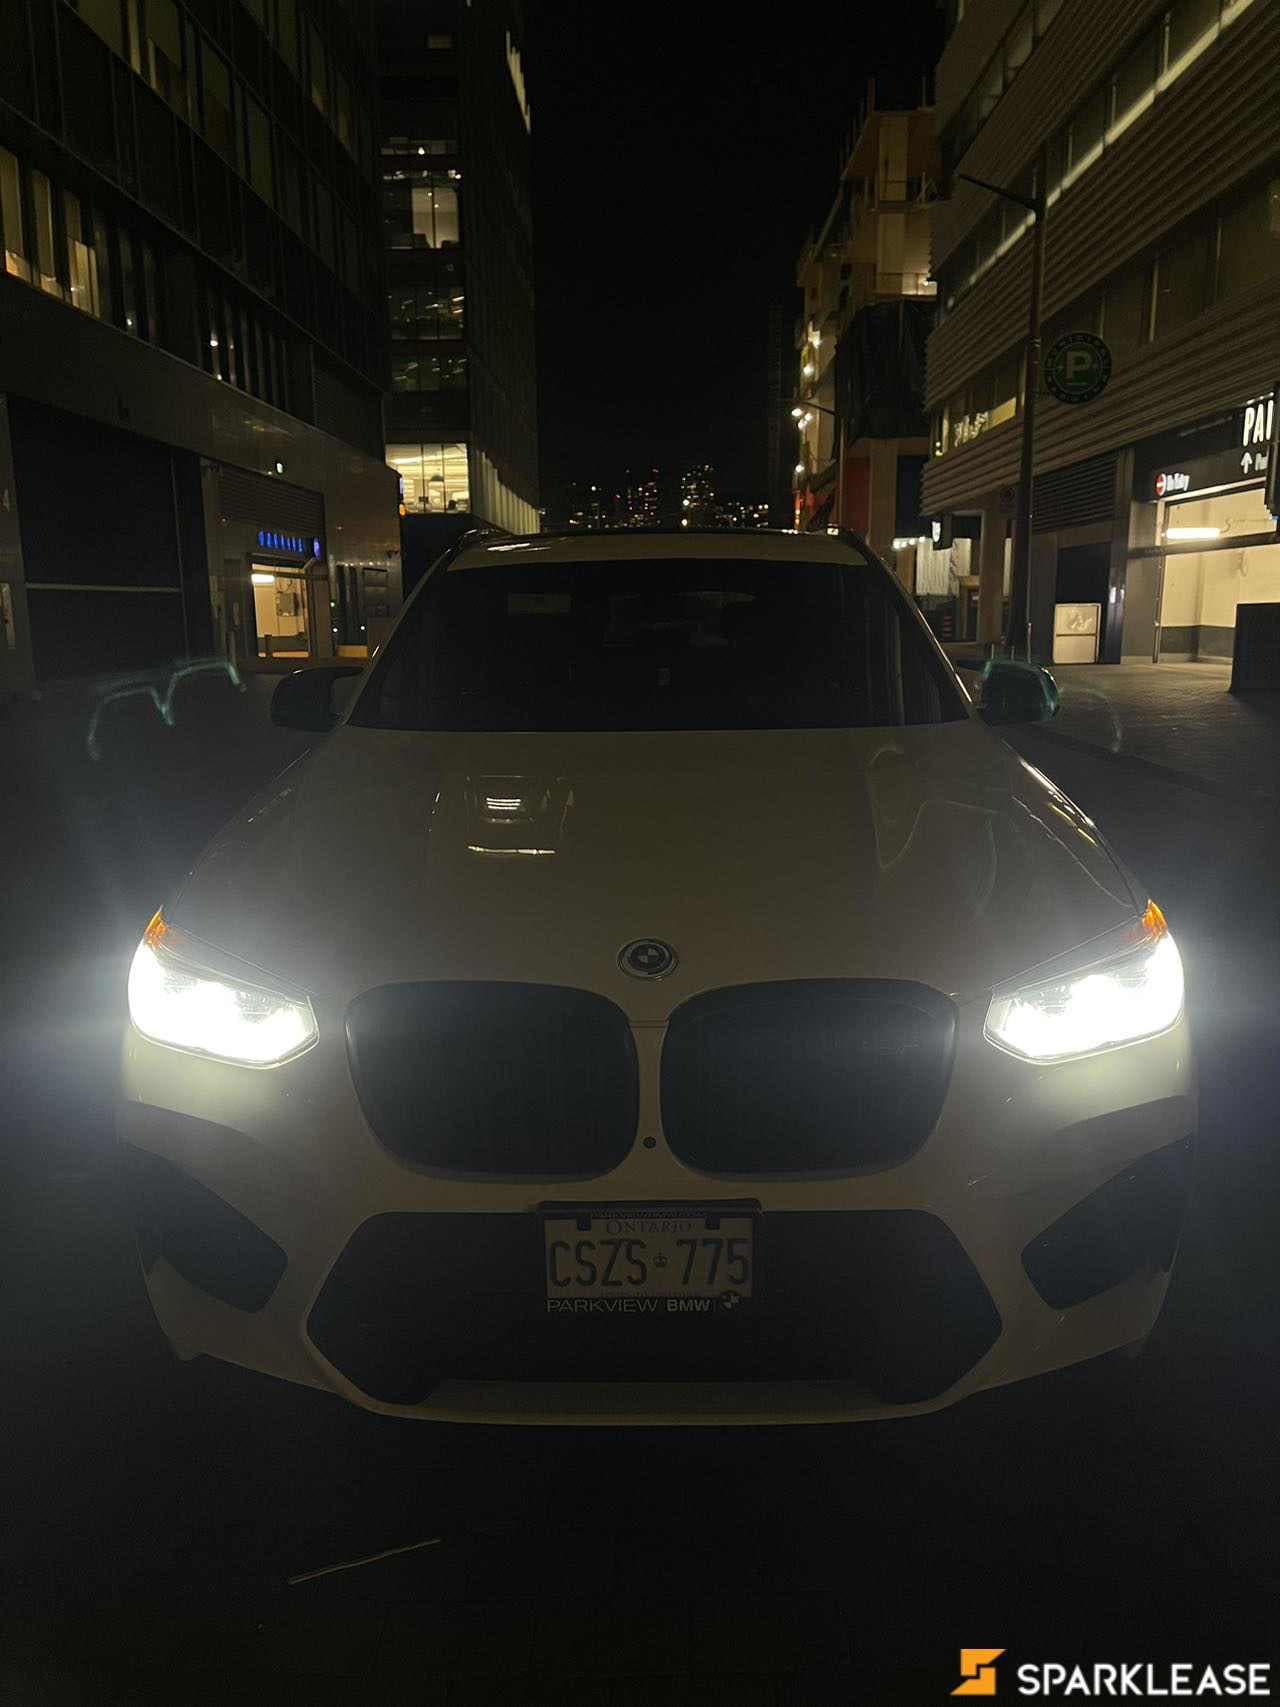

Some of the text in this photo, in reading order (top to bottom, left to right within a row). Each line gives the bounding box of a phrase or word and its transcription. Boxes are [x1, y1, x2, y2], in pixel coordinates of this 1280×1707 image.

[1066, 350, 1091, 378] P
[607, 1218, 692, 1234] ONTARIO
[551, 1238, 751, 1287] CSZS 775
[546, 1298, 712, 1312] PARKVIEW BMW
